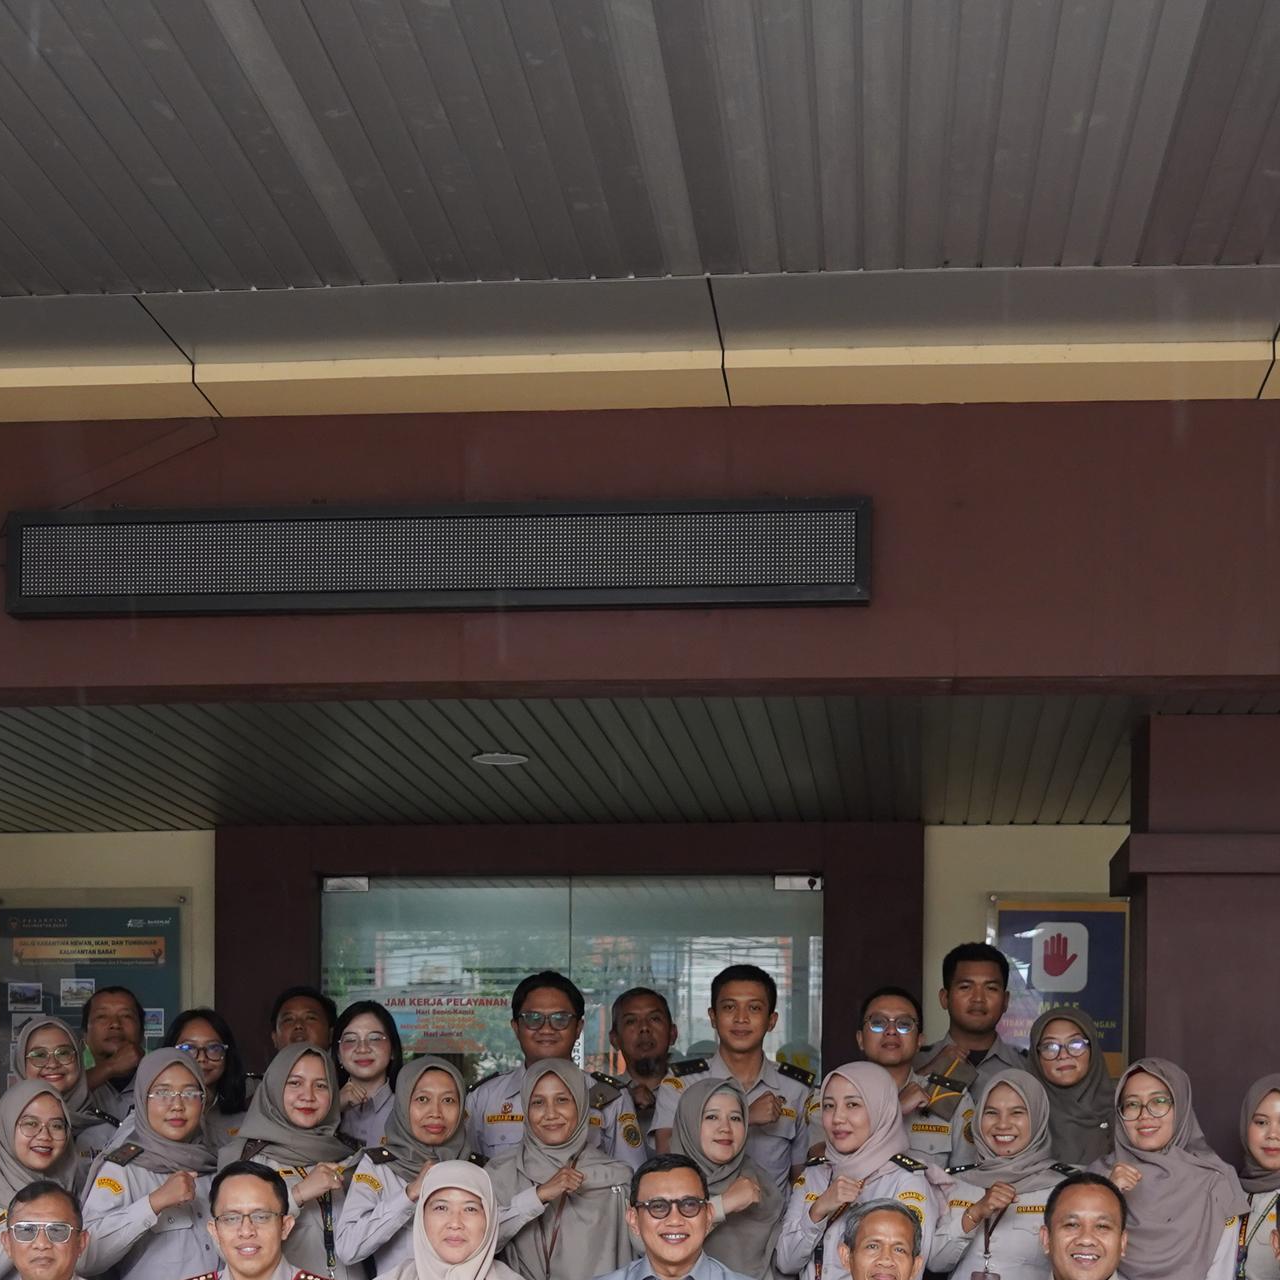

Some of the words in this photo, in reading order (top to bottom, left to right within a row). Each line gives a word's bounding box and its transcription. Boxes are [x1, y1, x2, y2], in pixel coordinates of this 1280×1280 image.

[385, 998, 406, 1007] JAM
[409, 998, 443, 1006] KERJA
[446, 997, 508, 1006] PELAYANAN
